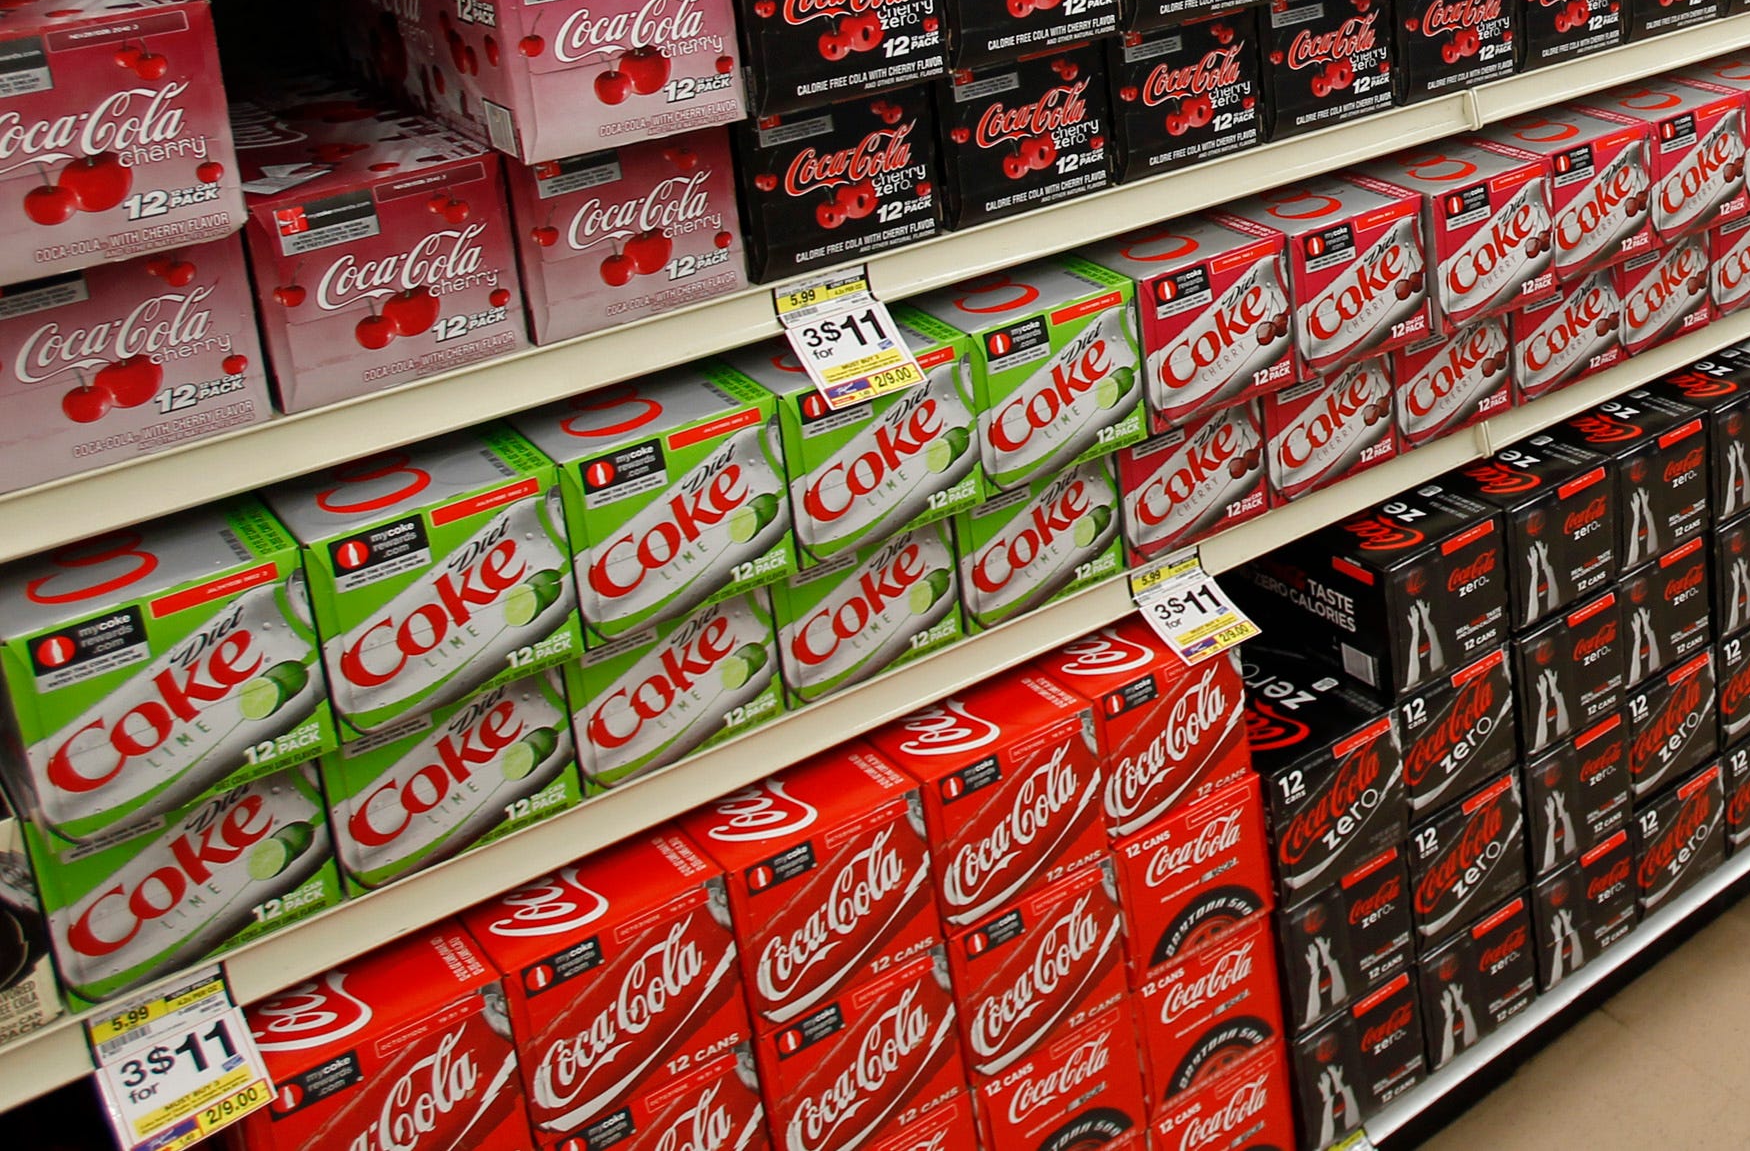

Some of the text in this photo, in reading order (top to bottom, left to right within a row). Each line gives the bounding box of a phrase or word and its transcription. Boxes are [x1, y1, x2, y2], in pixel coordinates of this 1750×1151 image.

[880, 12, 919, 31] zero
[657, 34, 724, 58] cherry
[883, 35, 940, 59] 12 PACK
[663, 75, 732, 103] 12 PACK
[797, 80, 829, 96] CALORIE
[829, 76, 848, 89] FREE
[849, 72, 868, 85] COLA
[868, 68, 888, 81] WITH
[888, 61, 916, 78] CHERRY
[917, 55, 944, 71] FLAVOR
[118, 135, 207, 168] cherry
[1656, 132, 1731, 214] Coke
[122, 187, 220, 222] 12 PACK
[34, 211, 229, 263] COCA-COLA WITH CHERRY FLAVOR
[1449, 200, 1534, 298] Coke
[790, 288, 816, 307] 5.99
[1306, 238, 1410, 342] Coke
[15, 281, 220, 384] Coca-Cola
[812, 346, 835, 361] for
[1161, 283, 1270, 390] Coke
[874, 366, 912, 389] 2/9.00
[1201, 340, 1246, 385] CHERRY
[587, 464, 749, 600] Coke
[1289, 588, 1357, 633] CALORIES
[1307, 578, 1355, 616] TASTE
[170, 604, 245, 666] Diet
[46, 628, 267, 794] Coke
[146, 717, 211, 770] LIME
[243, 728, 322, 765] 12 PACK
[1440, 716, 1492, 774] zero
[942, 739, 1077, 927] Coca-Cola
[1124, 831, 1171, 859] 12 CANS
[1144, 806, 1244, 888] Coca-Cola
[111, 1005, 149, 1032] 5.99
[532, 911, 704, 1114] Coca-Cola
[667, 1033, 741, 1077] 12 CANS
[129, 1081, 160, 1105] for
[206, 1086, 258, 1125] 2/9.00
